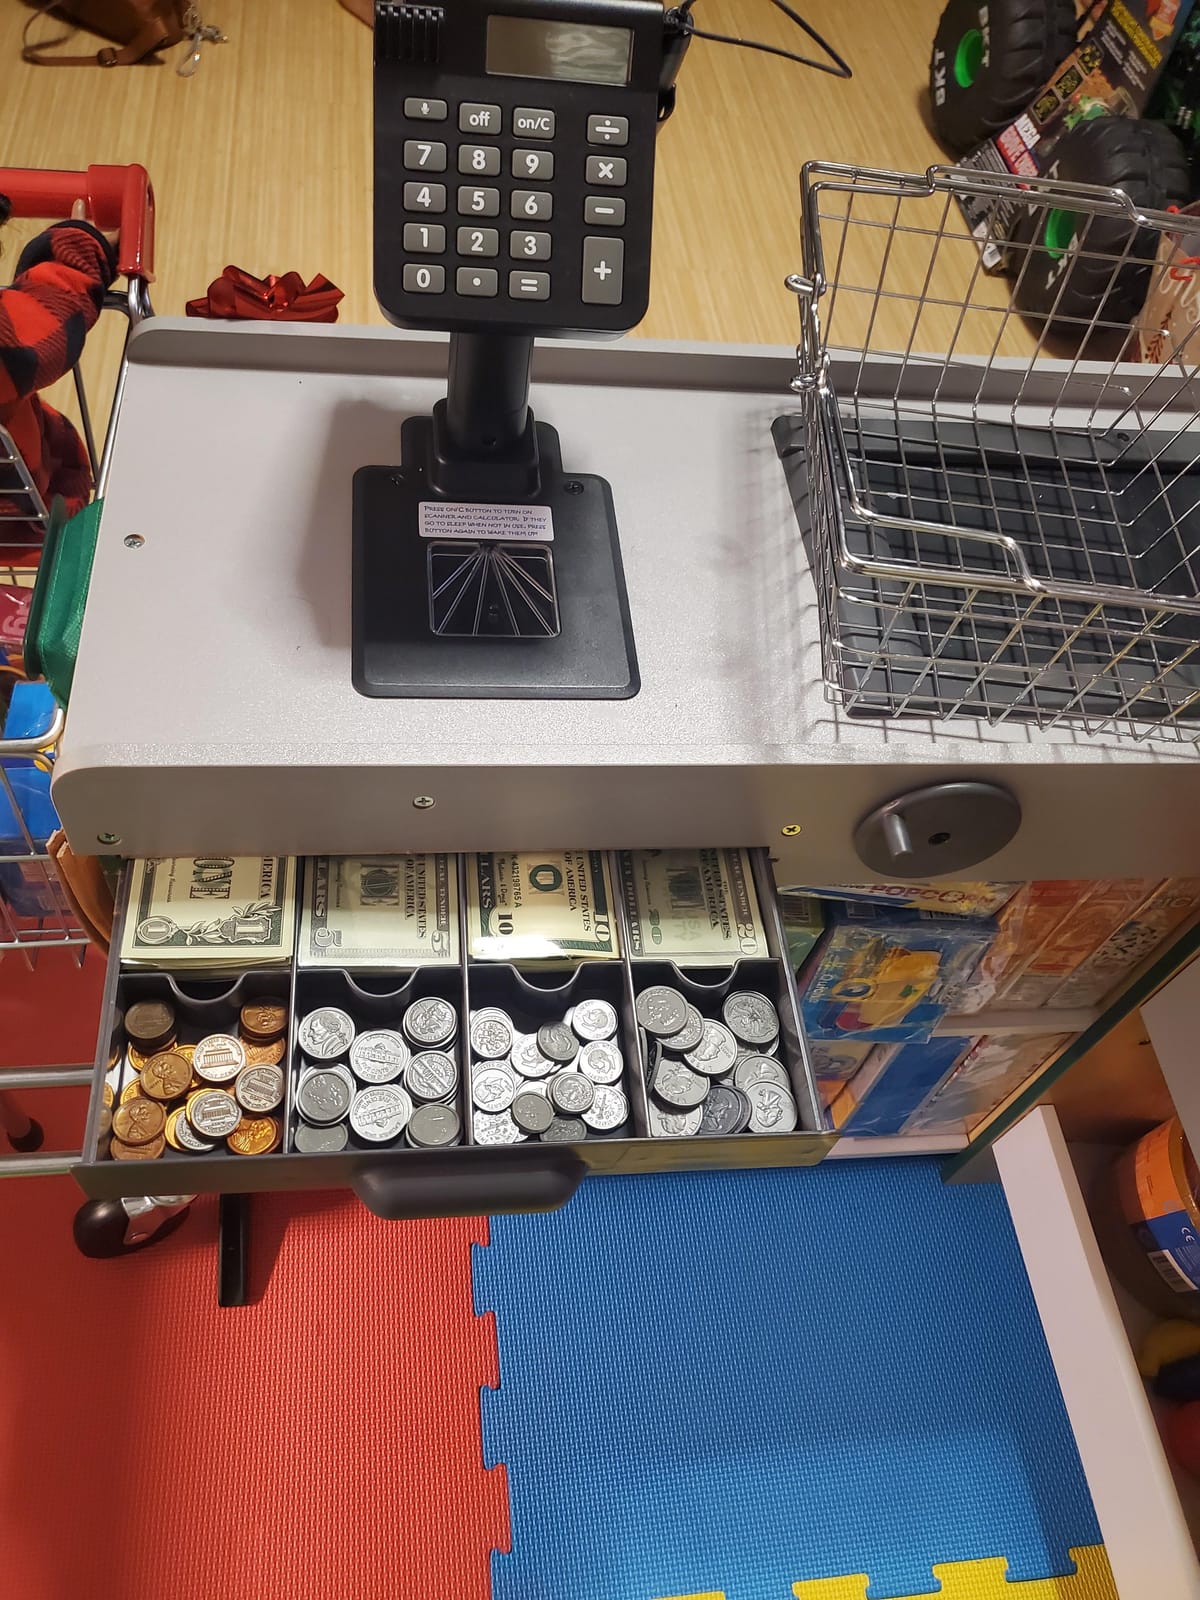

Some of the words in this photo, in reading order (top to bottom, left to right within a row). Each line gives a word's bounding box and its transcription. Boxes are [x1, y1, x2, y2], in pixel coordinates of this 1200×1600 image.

[469, 110, 491, 127] off
[517, 116, 551, 131] on/C
[417, 146, 431, 166] 7
[472, 150, 486, 170] 8
[525, 154, 539, 174] 9
[416, 187, 431, 208] 4
[471, 191, 485, 211] 5
[524, 195, 538, 215] 6
[419, 228, 429, 248] 1
[471, 232, 484, 252] 2
[524, 236, 537, 256] 3
[416, 269, 431, 288] 0
[406, 859, 415, 869] OF
[565, 852, 573, 866] OF
[190, 857, 235, 899] ONE
[260, 857, 274, 899] ERICA
[416, 862, 426, 896] UNITED
[480, 860, 492, 909] LARS
[576, 856, 587, 892] UNITED
[315, 861, 327, 918] LARS
[405, 869, 415, 920] AMERICA
[566, 867, 577, 911] AMERICA
[703, 868, 720, 929] AMERICA
[869, 884, 996, 905] POPCORN
[417, 896, 428, 939] STATES
[498, 912, 514, 935] 10
[580, 894, 591, 932] STATES
[593, 911, 612, 942] 10
[313, 927, 342, 948] 5
[431, 930, 450, 953] 5
[737, 922, 759, 955] 20
